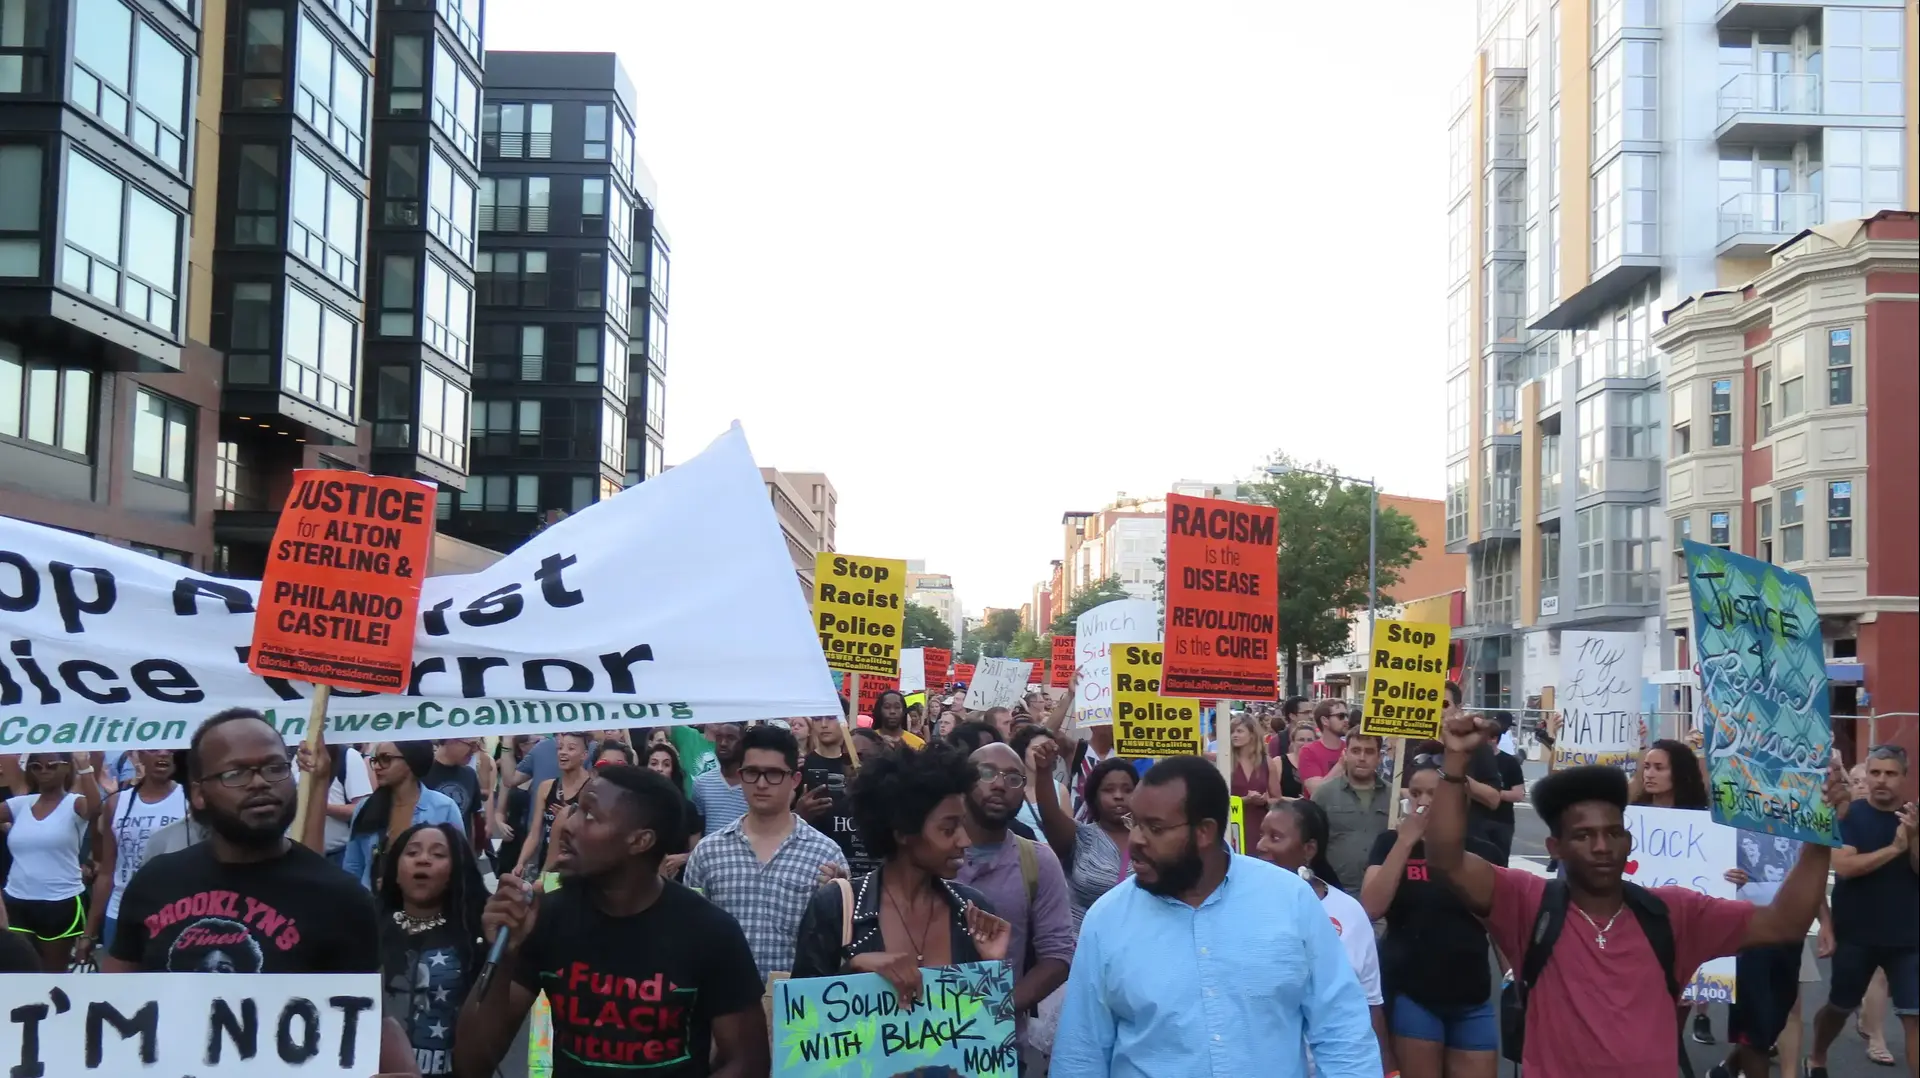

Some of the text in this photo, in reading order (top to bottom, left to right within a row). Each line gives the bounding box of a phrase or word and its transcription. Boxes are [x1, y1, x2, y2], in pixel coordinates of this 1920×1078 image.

[290, 480, 424, 525] JUSTICE
[297, 516, 402, 550] for ALTON
[1171, 503, 1274, 546] RACISM
[277, 540, 413, 578] STERLING &
[1205, 545, 1240, 566] is the
[833, 557, 889, 583] Stop
[1183, 566, 1259, 596] DISEASE
[274, 581, 402, 620] PHILANDO
[820, 583, 899, 609] Racist
[1696, 572, 1799, 640] JUSTICE
[278, 610, 391, 646] CASTILE!
[820, 612, 896, 638] Police
[1082, 611, 1135, 637] Which
[1172, 606, 1274, 634] REVOLUTION
[819, 632, 895, 657] Terror
[1175, 635, 1268, 660] is the CURE!
[1388, 624, 1436, 648] Stop
[855, 656, 892, 666] Coalition
[1375, 650, 1443, 673] Racist
[1575, 637, 1625, 682] My
[1748, 640, 1765, 677] 4
[863, 681, 891, 690] ALTON
[1372, 679, 1438, 701] Police
[1566, 669, 1632, 707] Life
[1119, 702, 1192, 720] Police
[1372, 699, 1436, 720] Terror
[0, 715, 187, 746] Coalition
[1120, 721, 1193, 740] Terror
[1370, 718, 1433, 728] ANSWER Coalition
[1122, 740, 1154, 748] ANSWER
[1556, 751, 1598, 764] UFCW
[144, 890, 300, 950] BROOKLYN'S
[176, 927, 250, 949] Finest
[569, 961, 664, 1001] Fund
[1700, 987, 1727, 999] 400
[784, 983, 804, 1025] IN
[10, 986, 375, 1078] I'M NOT
[800, 1018, 987, 1062] WITH BLACK
[964, 1045, 1016, 1075] MOMS
